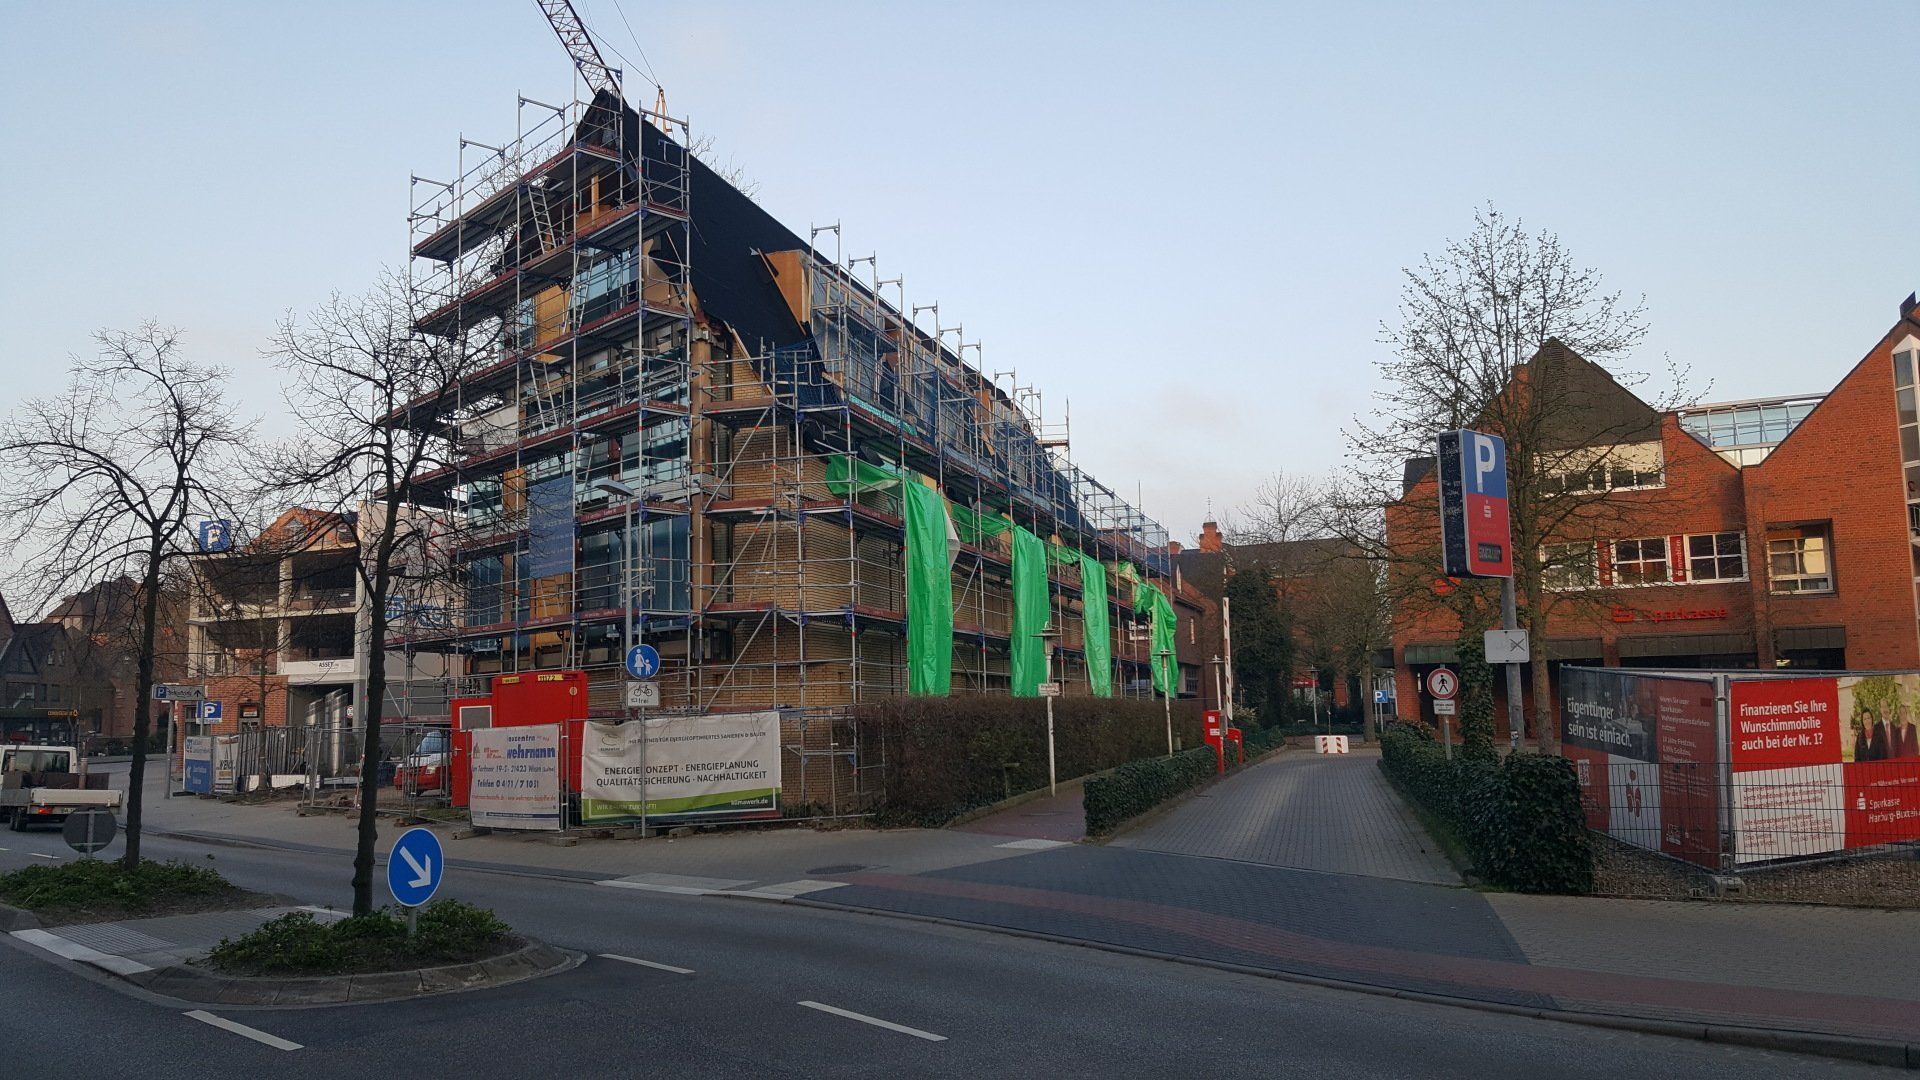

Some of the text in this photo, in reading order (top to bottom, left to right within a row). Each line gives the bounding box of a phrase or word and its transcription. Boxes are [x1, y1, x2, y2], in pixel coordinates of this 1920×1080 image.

[1474, 434, 1496, 493] P
[1375, 691, 1383, 702] P
[205, 705, 216, 718] P
[1567, 697, 1614, 720] Eigentümer
[1740, 699, 1827, 717] Finanzieren Sie Ihre
[1740, 716, 1821, 733] Wunschimmobilie
[1568, 721, 1633, 748] sein ist einfach.
[1741, 732, 1823, 751] auch bei der Nr. 1?
[507, 744, 556, 759] wehrmann
[604, 760, 759, 775] ENERGIEONZEPT ENERGIEPLANUNG
[596, 771, 767, 787] QUALITÄTSSICHERUNG NACHHALTIGKEIT
[1869, 798, 1901, 811] Sparkasse
